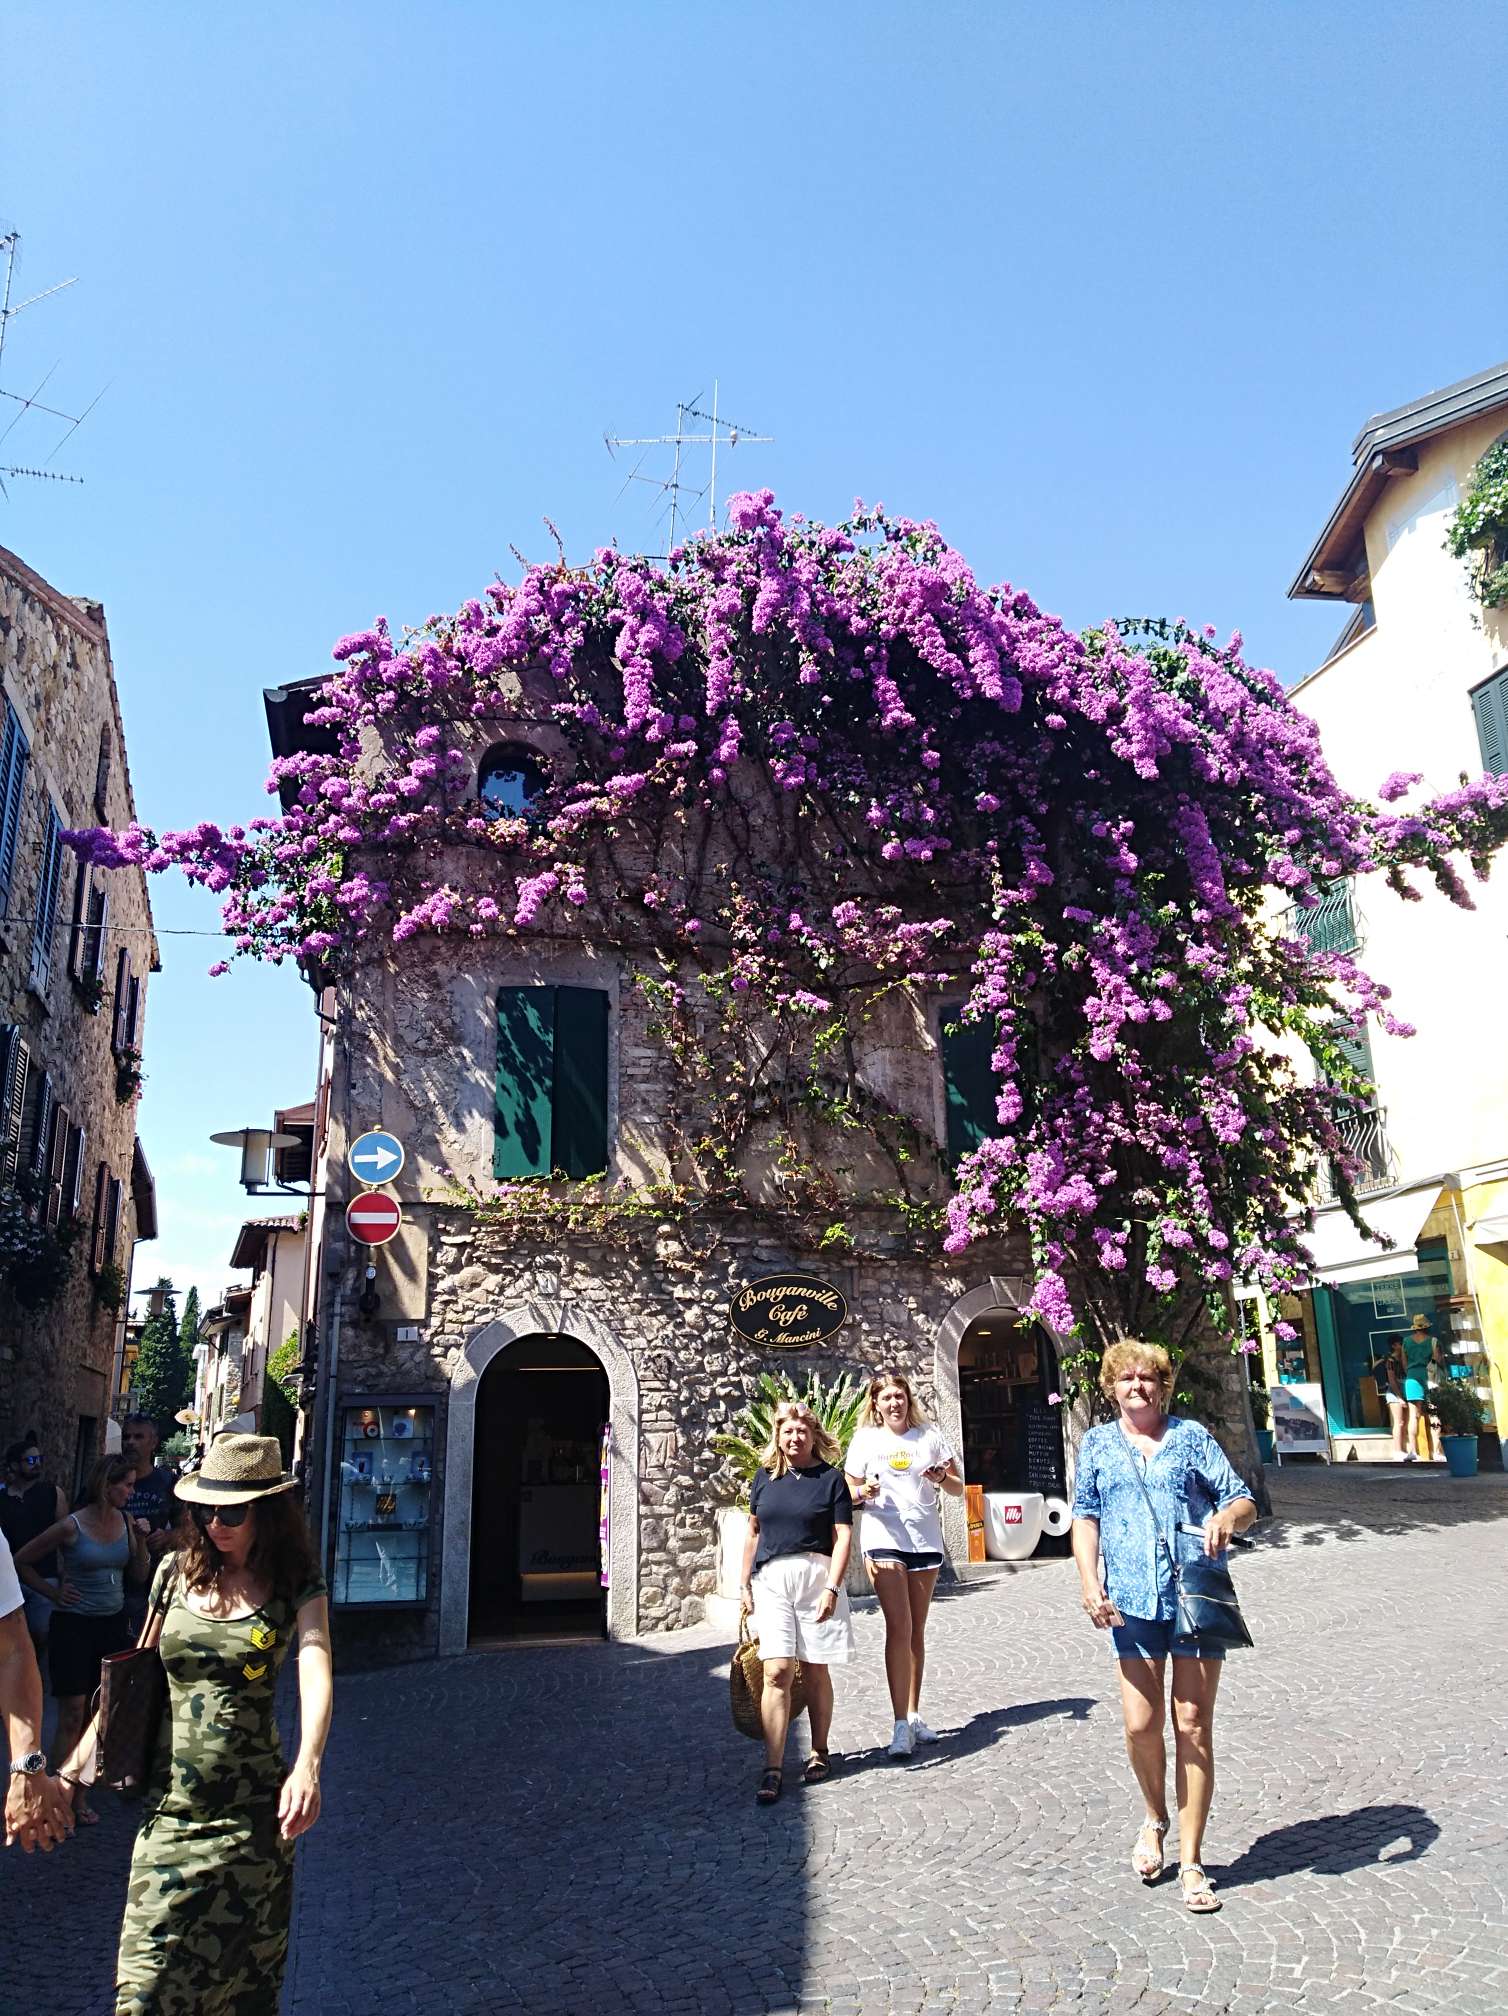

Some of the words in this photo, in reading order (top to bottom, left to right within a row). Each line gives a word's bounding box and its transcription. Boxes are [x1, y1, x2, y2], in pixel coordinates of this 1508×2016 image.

[738, 1286, 838, 1312] Bouganville
[770, 1327, 821, 1344] Mancini
[1005, 1508, 1022, 1523] illy
